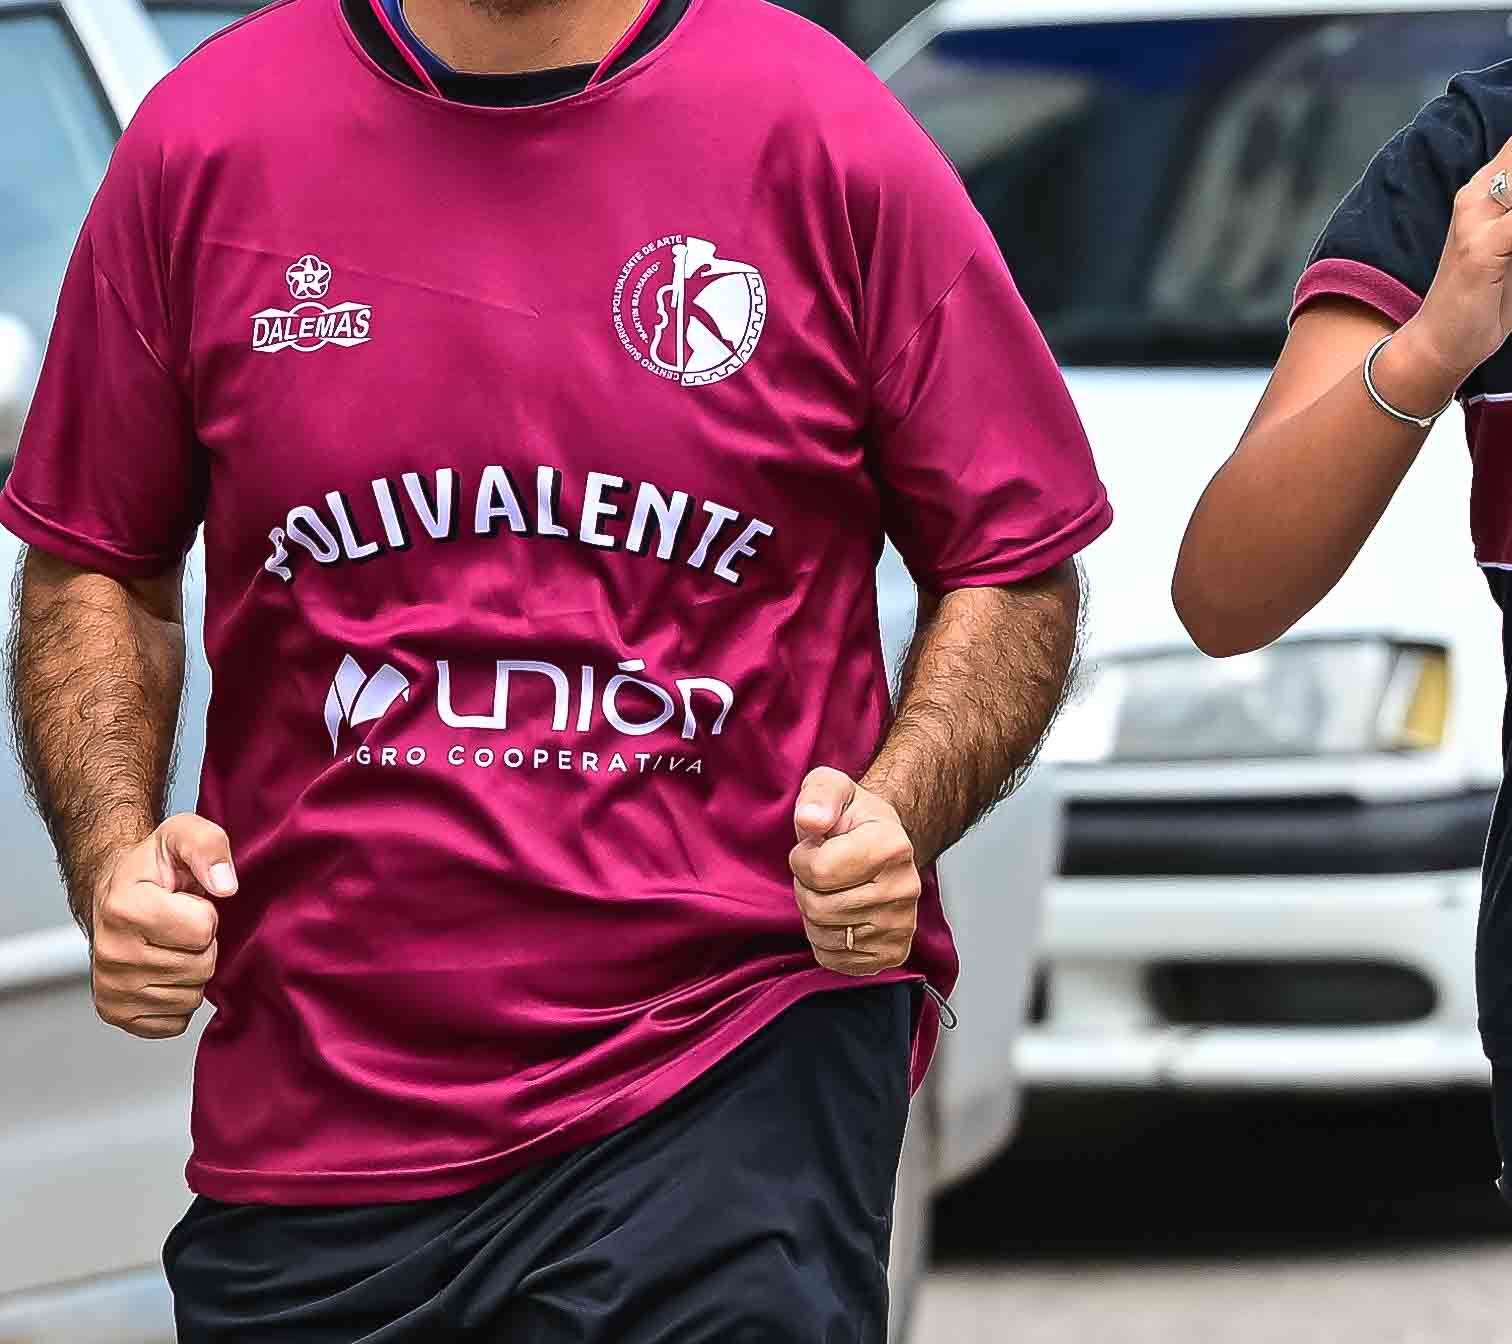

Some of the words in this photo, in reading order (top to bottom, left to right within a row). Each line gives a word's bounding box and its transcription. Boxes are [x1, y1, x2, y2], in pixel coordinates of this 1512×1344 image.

[641, 242, 656, 255] DE
[612, 251, 644, 313] POLIVALENTE
[252, 308, 372, 348] DALEMAS
[613, 315, 642, 360] SUPERIOR
[641, 358, 680, 380] CENTRO
[447, 745, 704, 775] COOPERATIVA
